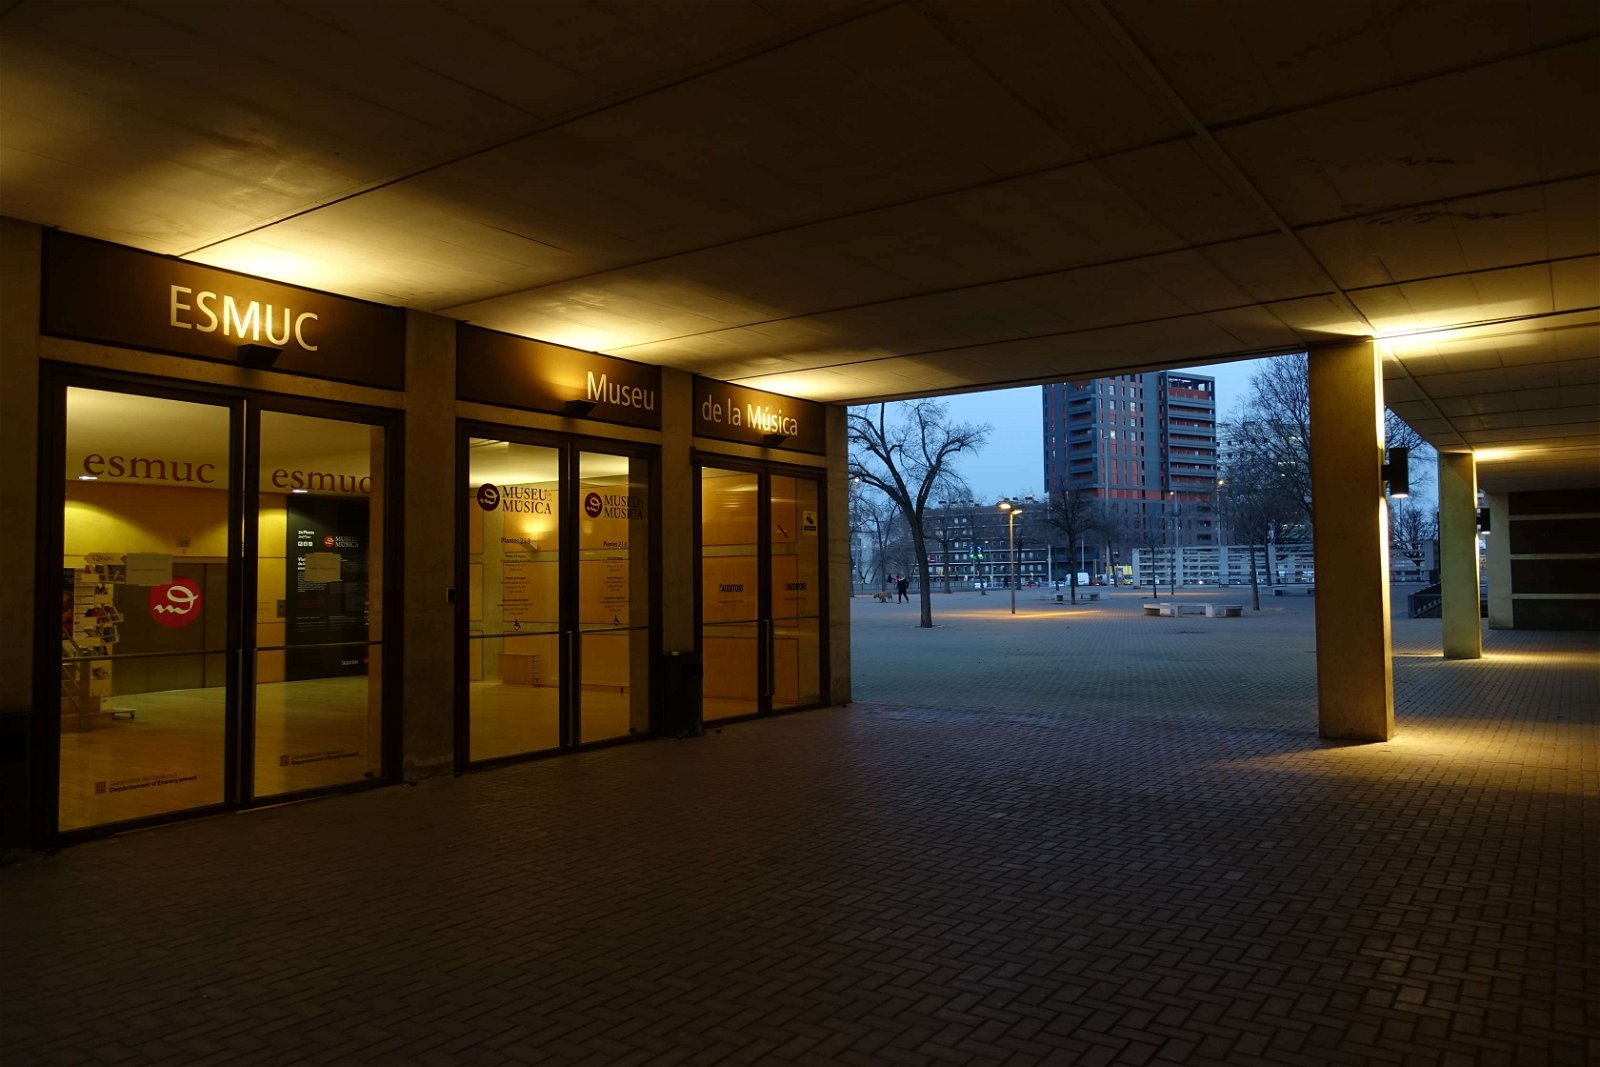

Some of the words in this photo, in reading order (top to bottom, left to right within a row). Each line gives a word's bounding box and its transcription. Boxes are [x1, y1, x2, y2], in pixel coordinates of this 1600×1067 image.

[170, 284, 318, 352] ESMUC
[587, 371, 654, 411] Museu
[701, 394, 722, 423] de
[728, 398, 741, 427] la
[747, 403, 798, 436] Música
[83, 453, 215, 484] esmuc
[272, 468, 374, 494] esmuc
[502, 486, 547, 501] MUSEU
[502, 499, 552, 515] MÚSICA
